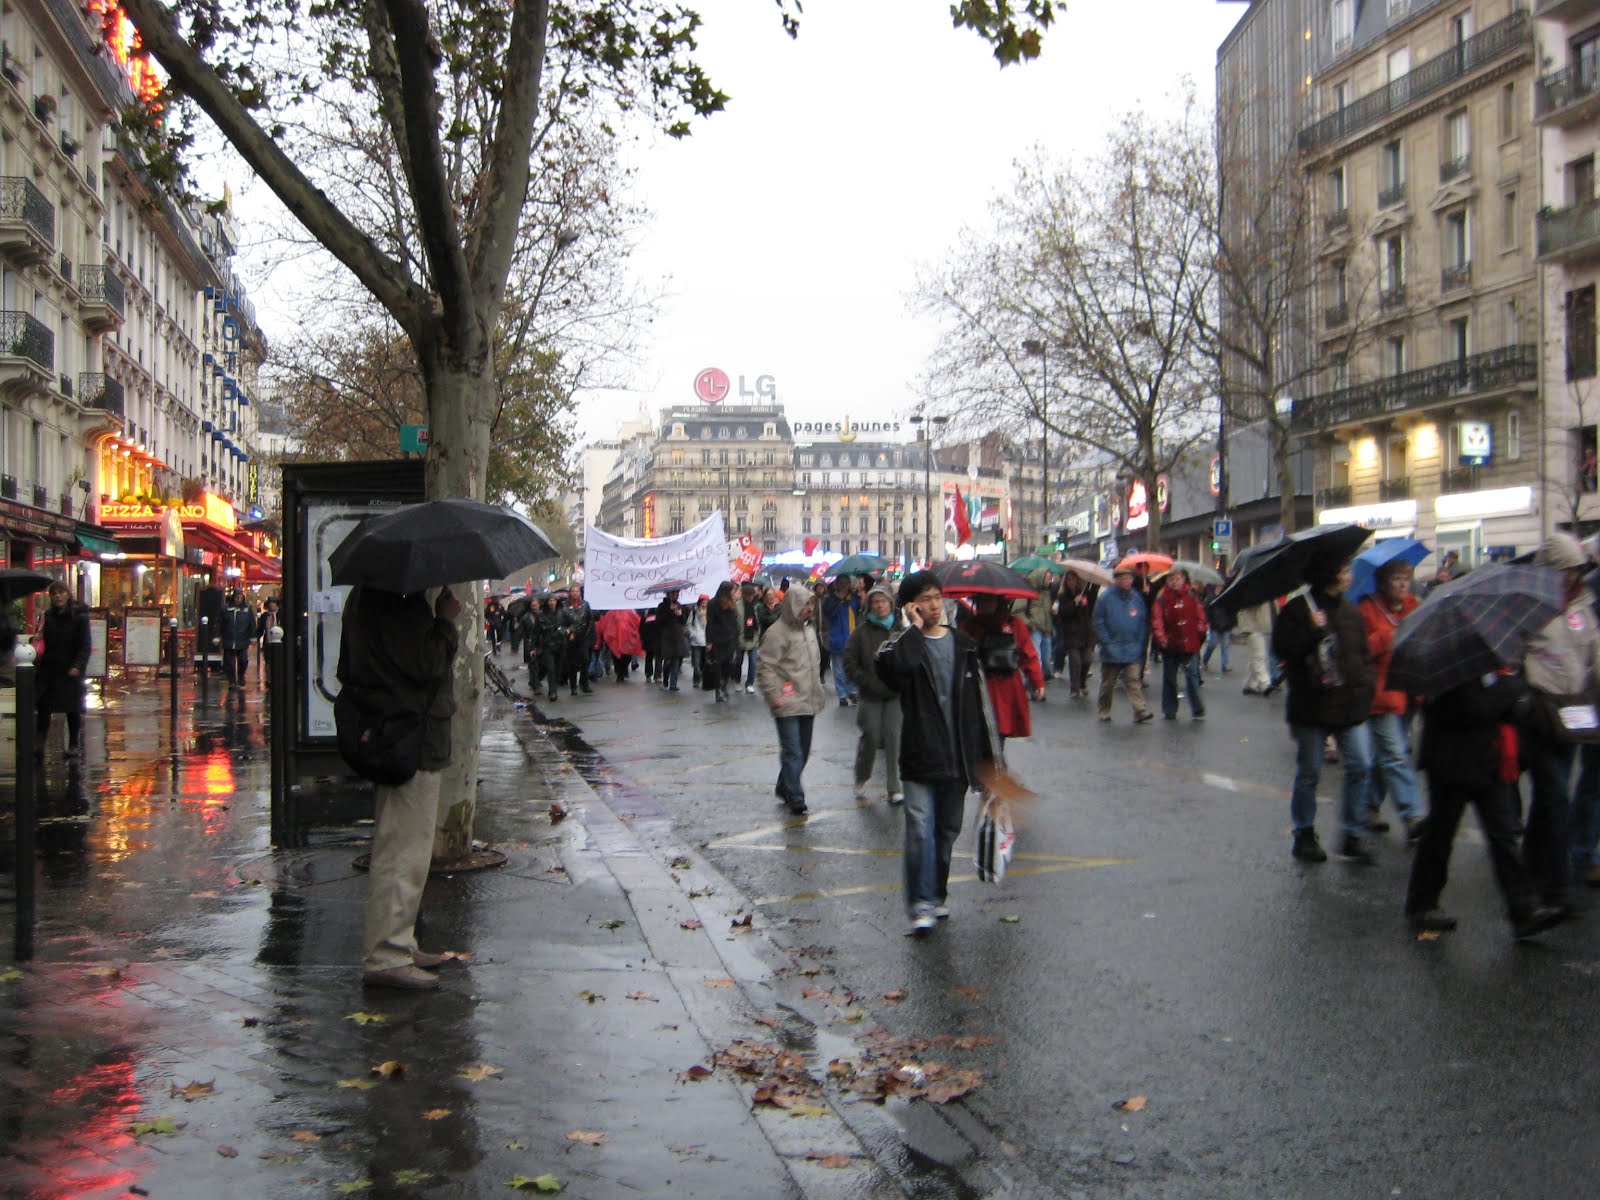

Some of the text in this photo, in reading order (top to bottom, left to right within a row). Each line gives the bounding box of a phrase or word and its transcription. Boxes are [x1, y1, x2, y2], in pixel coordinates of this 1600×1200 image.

[738, 374, 776, 398] LG
[249, 464, 258, 500] HOTEL
[100, 504, 155, 518] PIZZA
[590, 564, 707, 583] SOCIAUX EN
